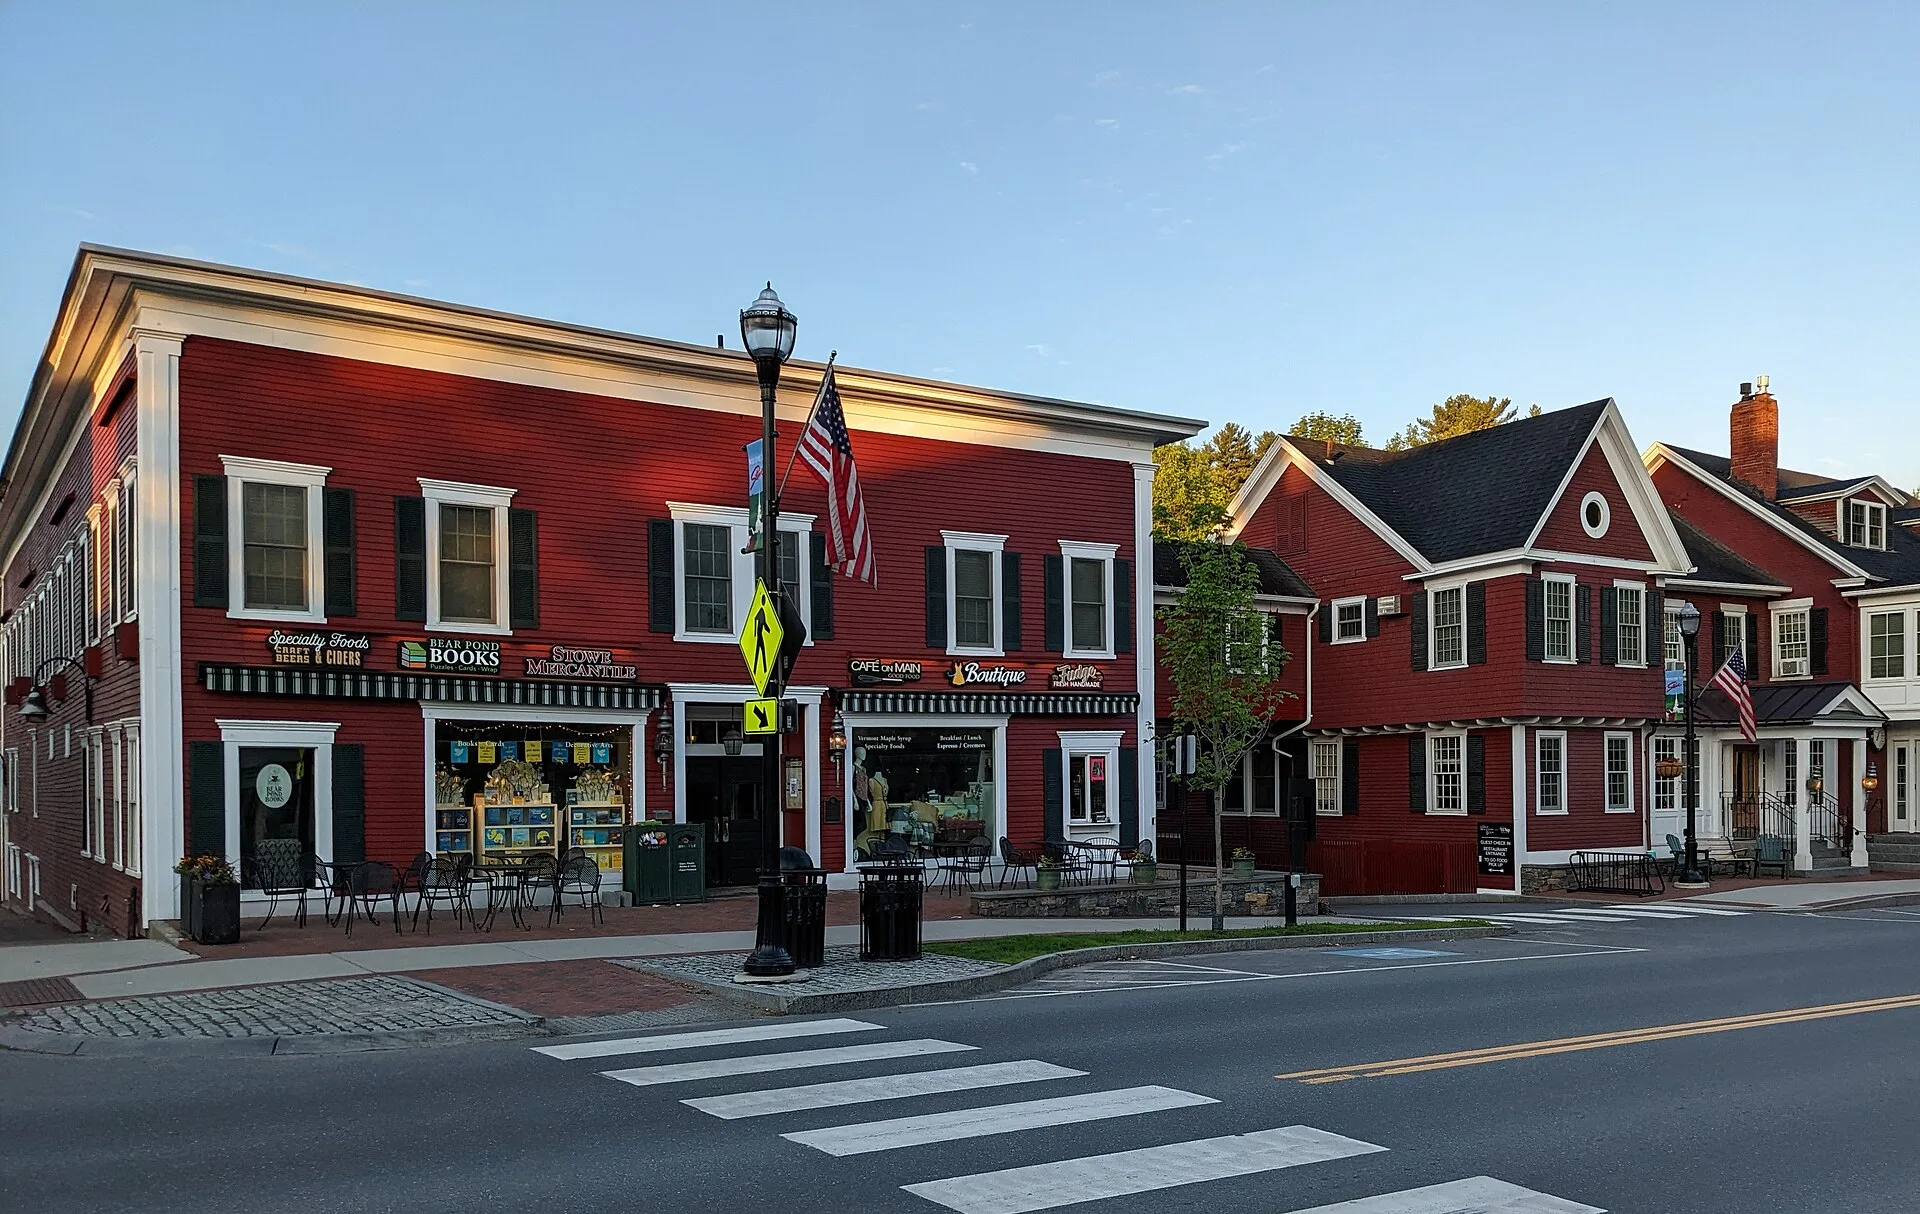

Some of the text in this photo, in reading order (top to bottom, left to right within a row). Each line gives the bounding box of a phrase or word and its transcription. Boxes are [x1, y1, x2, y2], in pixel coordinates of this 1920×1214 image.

[268, 630, 369, 652] Specialty Foods
[430, 639, 500, 651] BEAR POND
[275, 646, 310, 655] CRAFT
[275, 650, 361, 666] BEERS & CIDERS
[429, 648, 500, 667] BOOKS
[552, 645, 612, 664] STOWE
[430, 663, 454, 671] Puzzles
[526, 658, 637, 679] MERCANTILE
[881, 664, 893, 673] ON
[894, 662, 921, 674] MAIN
[965, 663, 1026, 687] Boutique
[1056, 665, 1097, 682] Fudge
